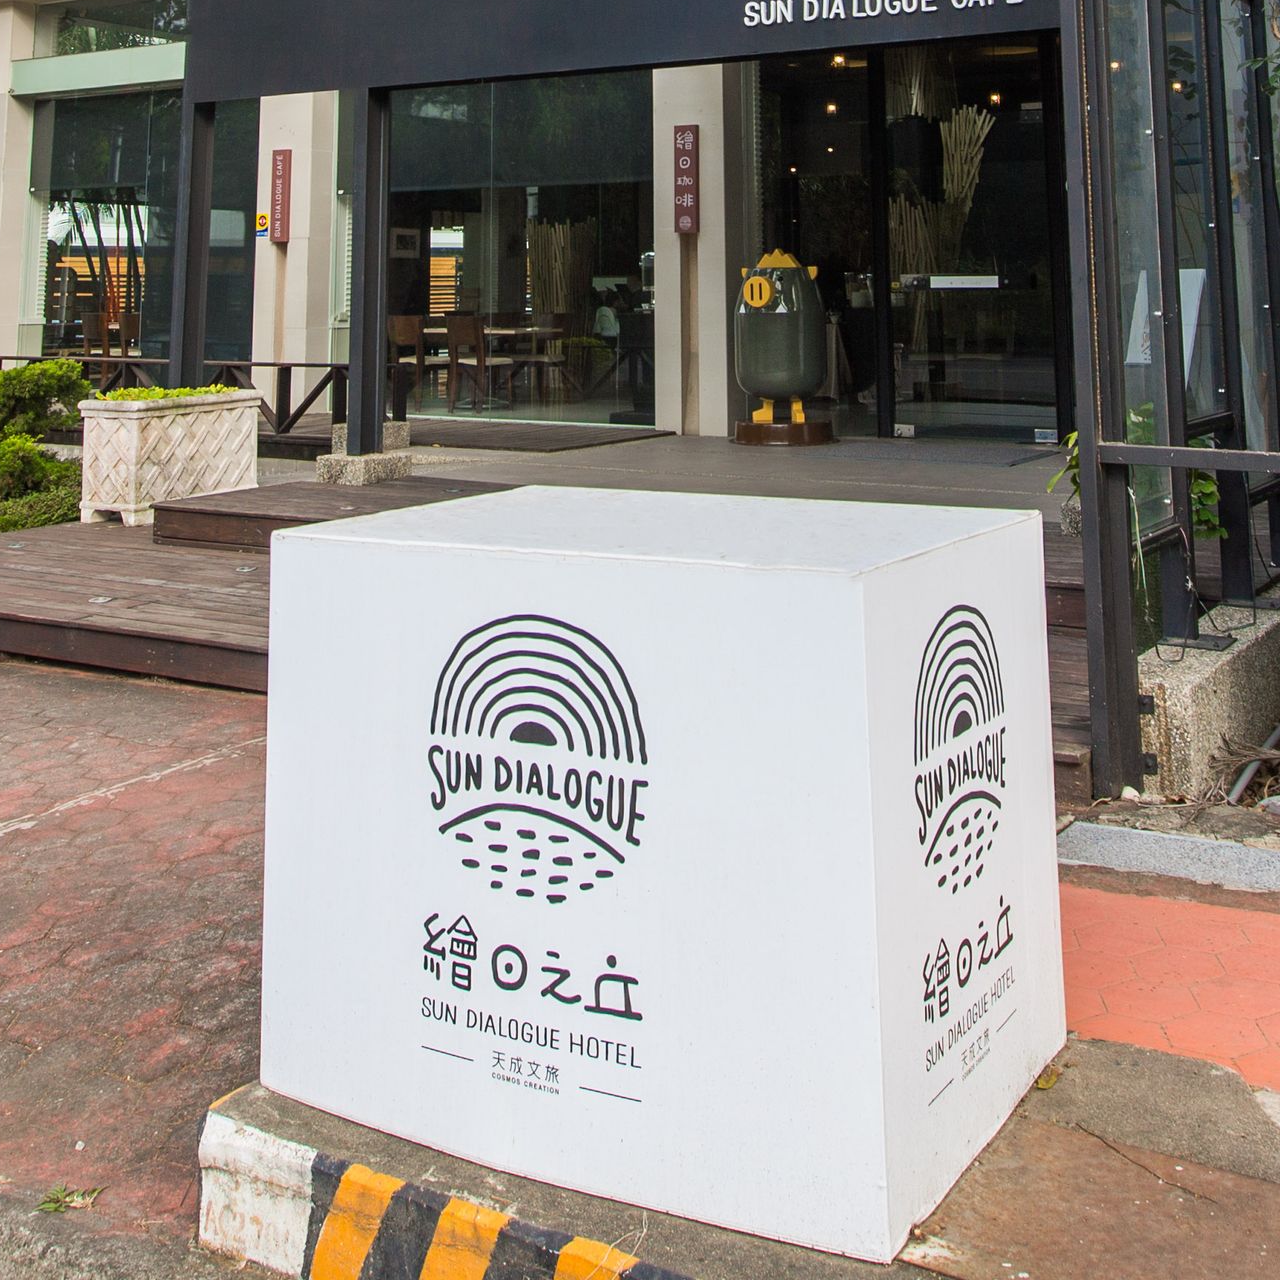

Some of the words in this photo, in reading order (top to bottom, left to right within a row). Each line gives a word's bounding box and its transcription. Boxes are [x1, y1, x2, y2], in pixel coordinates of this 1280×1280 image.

[744, 0, 793, 26] SUN
[428, 745, 482, 810] SUN
[495, 756, 648, 846] DIALOGUE
[915, 766, 943, 845] SUN
[948, 727, 1006, 795] DIALOGUE
[422, 997, 456, 1024] SUN
[467, 1009, 559, 1050] DIALOGUE
[570, 1033, 641, 1068] HOTEL
[926, 1037, 944, 1072] SUN
[948, 993, 988, 1050] DIALOGUE
[991, 966, 1015, 1001] HOTEL
[492, 1051, 559, 1083] 天成文旅
[492, 1072, 520, 1085] COSMOS
[524, 1081, 559, 1094] CREATION
